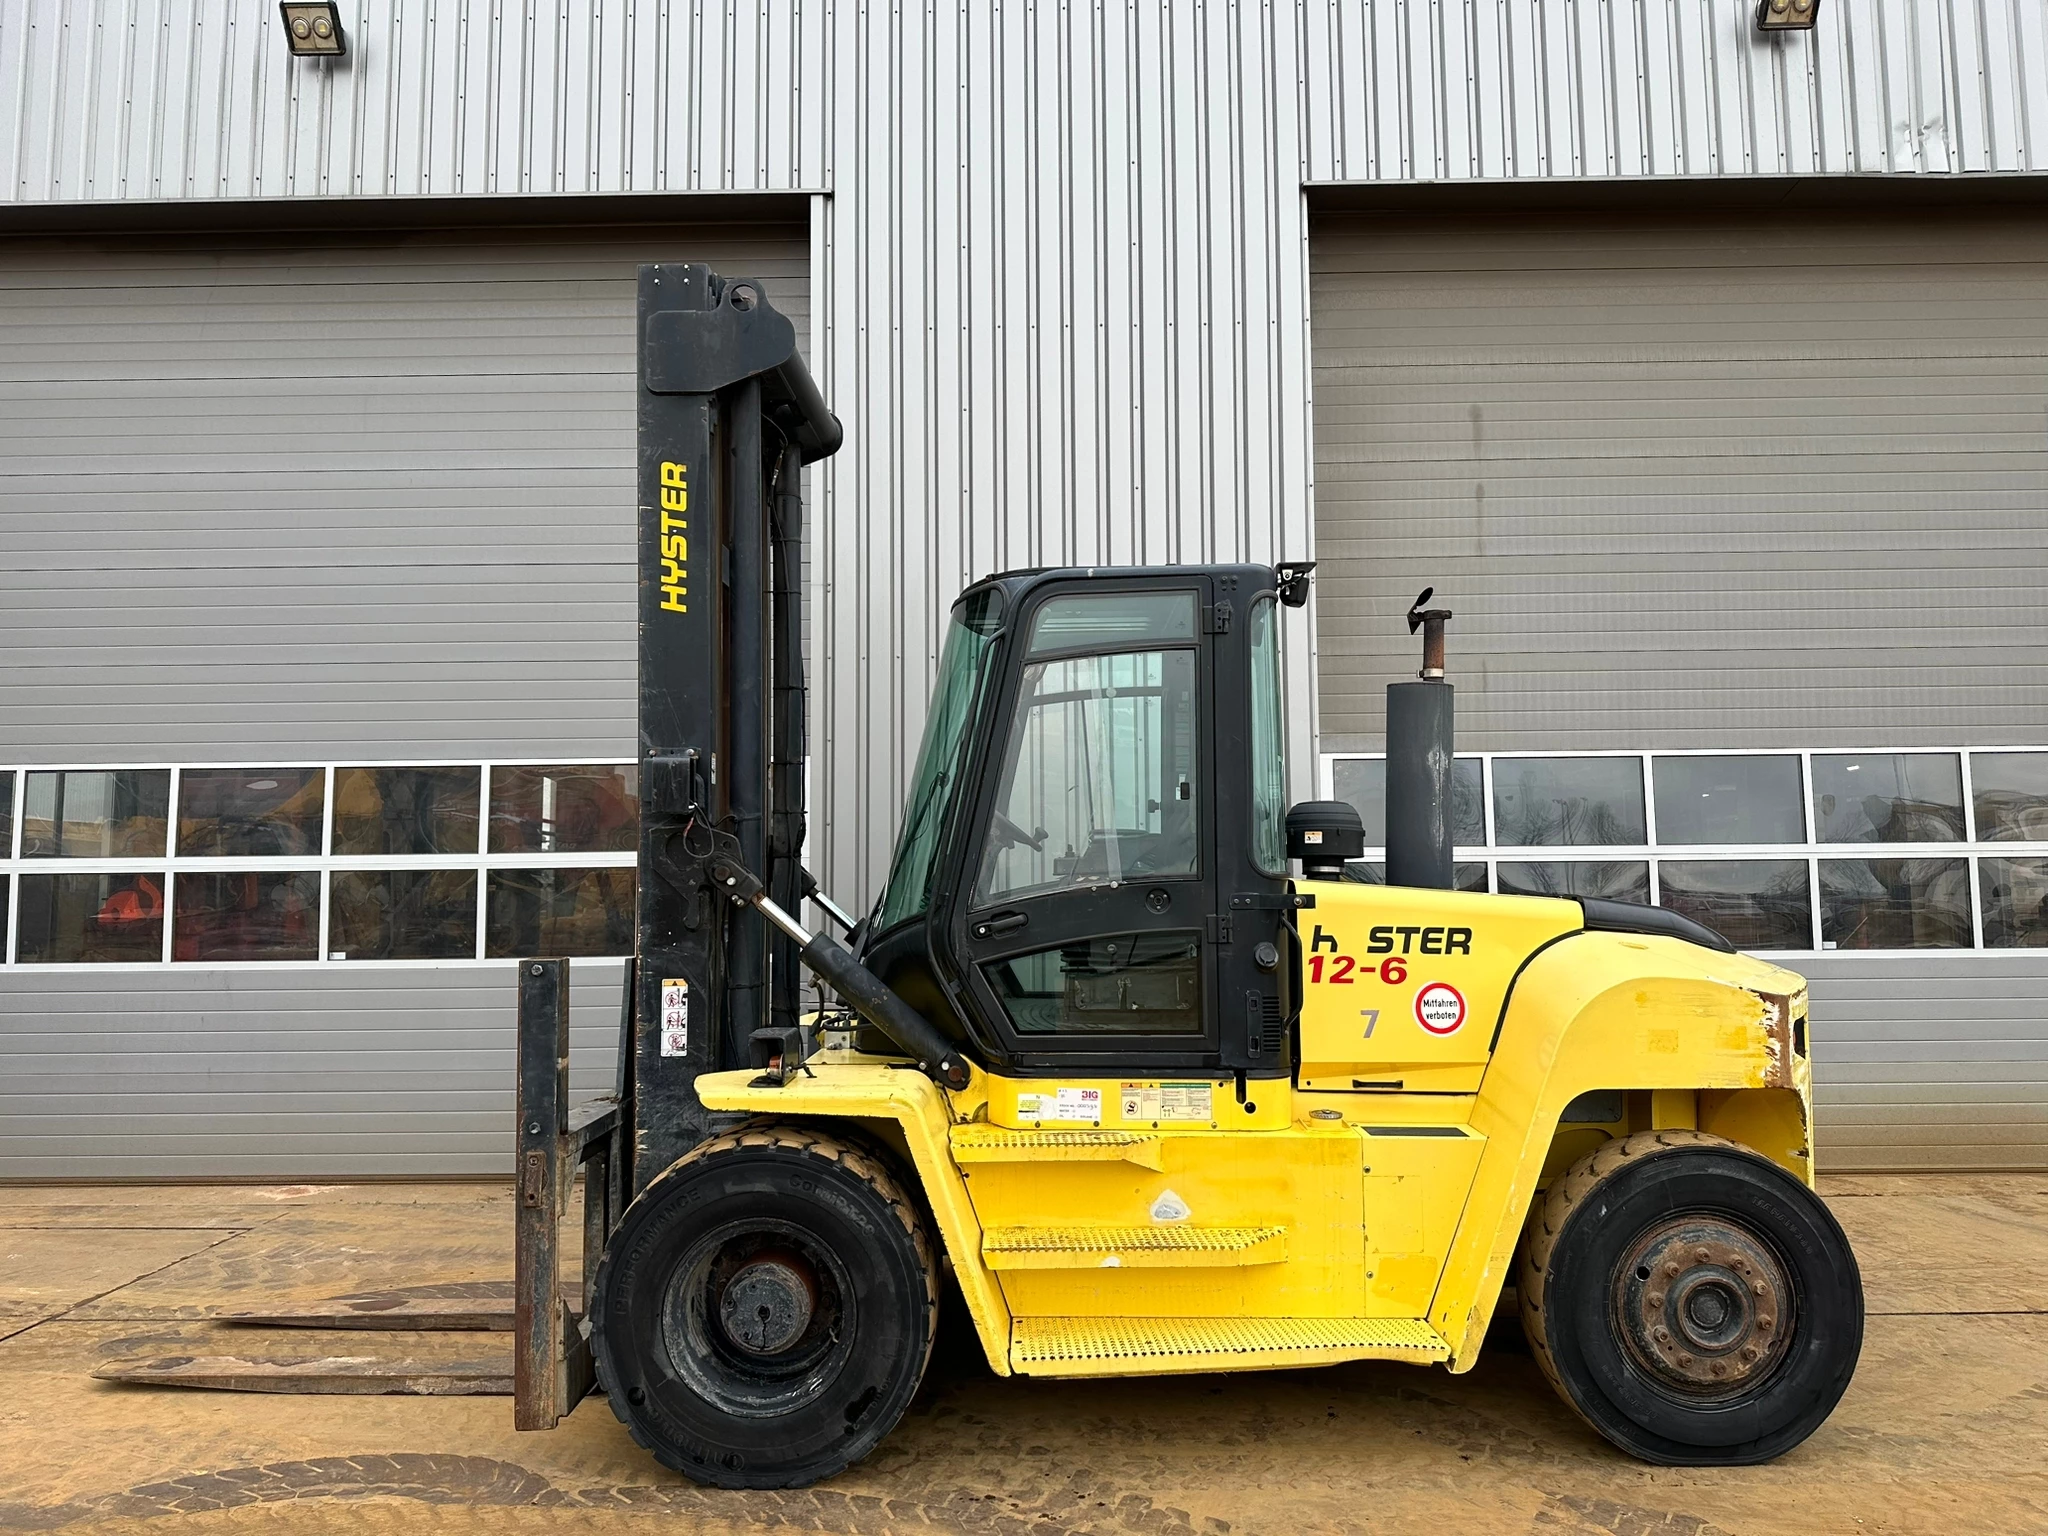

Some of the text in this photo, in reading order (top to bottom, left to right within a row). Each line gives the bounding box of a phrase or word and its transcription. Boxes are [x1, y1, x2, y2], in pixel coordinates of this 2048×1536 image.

[660, 461, 687, 613] HYSTER
[1308, 955, 1408, 984] 12-6
[1423, 999, 1458, 1008] Mitfahren
[1425, 1011, 1457, 1020] verboten
[1360, 1010, 1380, 1038] 7
[614, 1186, 702, 1315] PERFORMANCE
